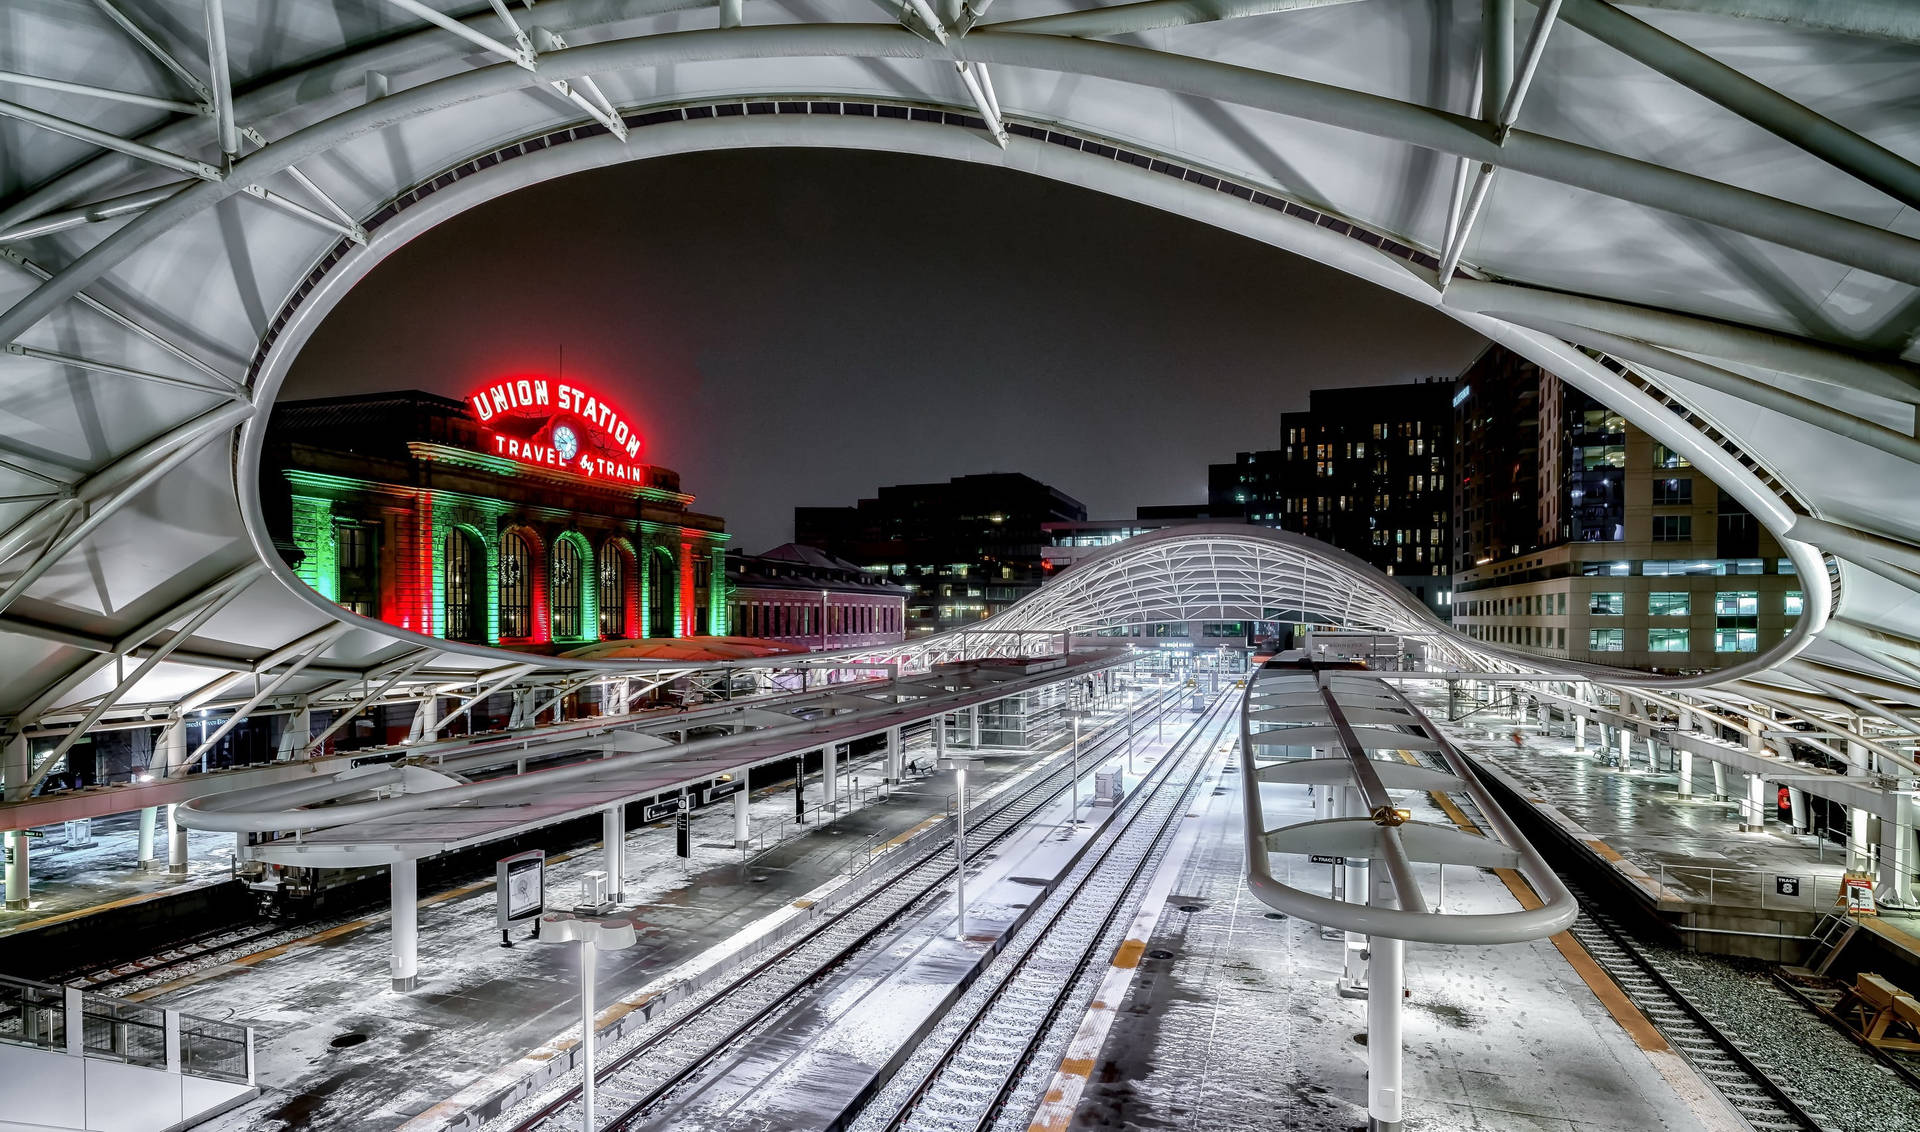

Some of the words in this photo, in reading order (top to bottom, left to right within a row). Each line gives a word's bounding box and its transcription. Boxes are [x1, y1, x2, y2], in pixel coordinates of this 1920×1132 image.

[473, 380, 549, 421] UNION
[558, 384, 641, 459] STATION
[495, 435, 567, 466] TRAVEL
[579, 454, 595, 476] by
[596, 458, 641, 482] TRAIN
[1782, 883, 1793, 893] 8
